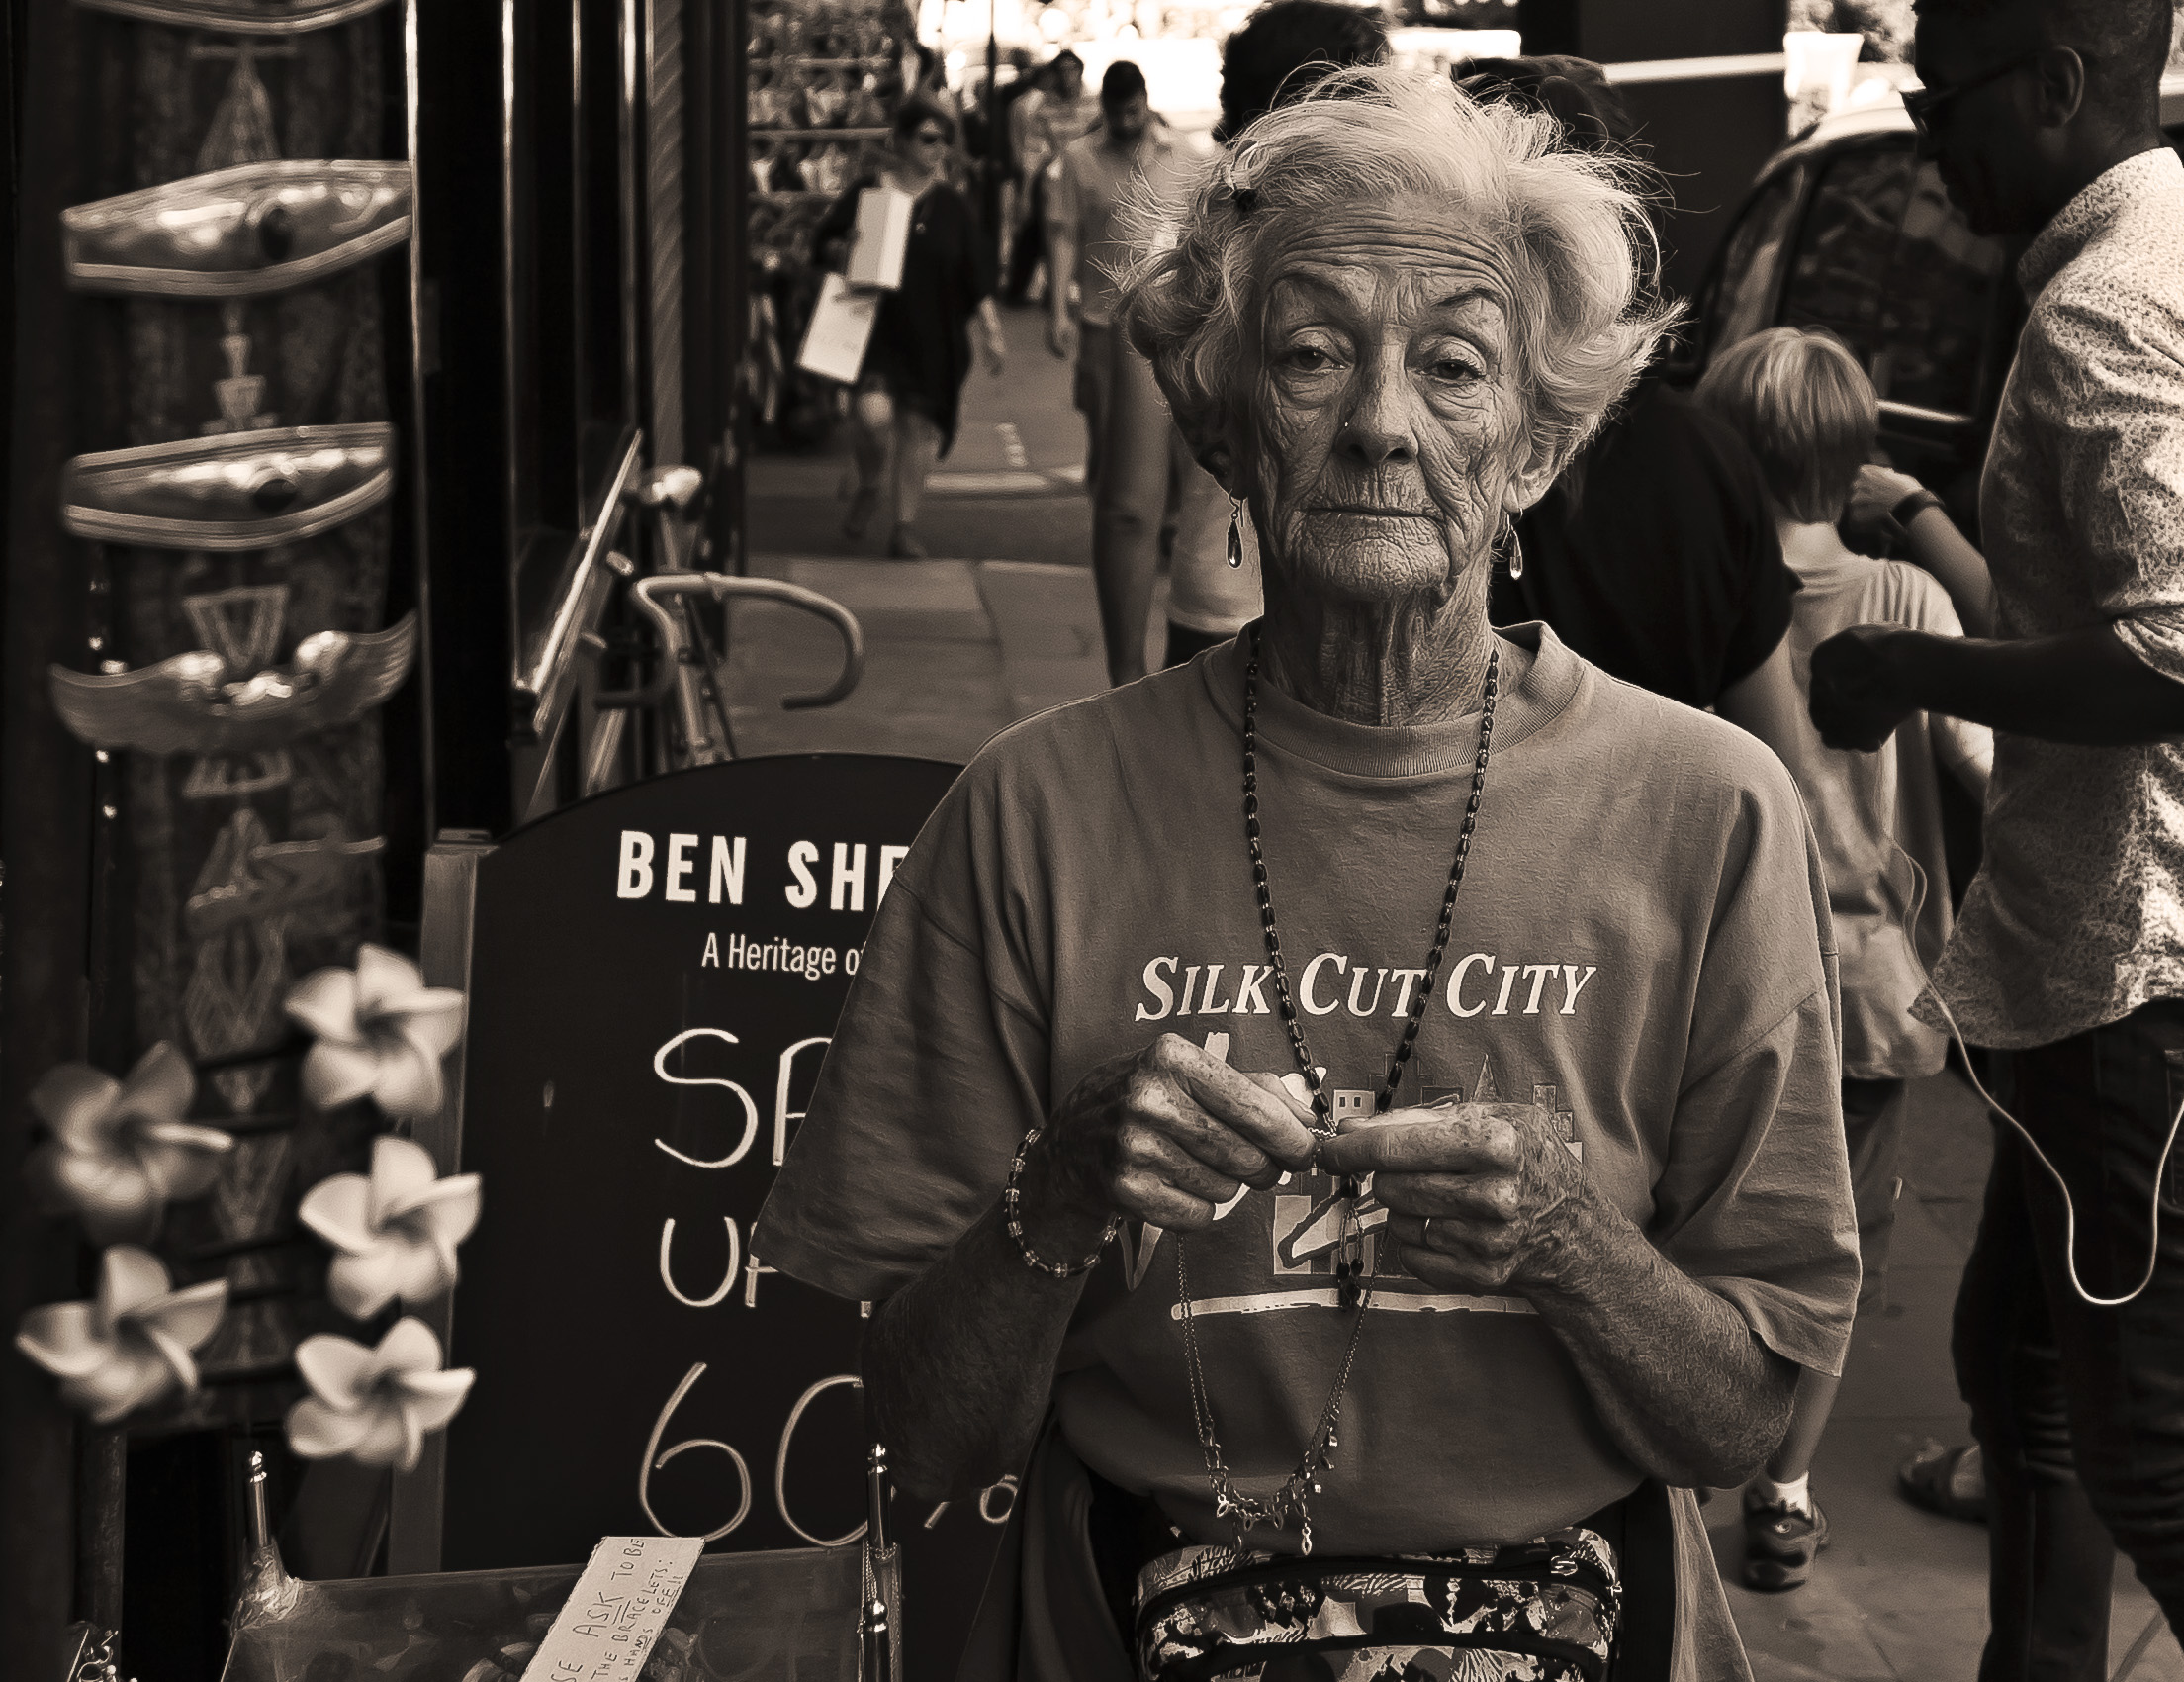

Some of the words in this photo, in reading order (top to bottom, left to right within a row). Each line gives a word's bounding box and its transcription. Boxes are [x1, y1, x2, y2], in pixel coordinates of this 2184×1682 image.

[616, 829, 747, 905] BEN
[701, 932, 720, 968] A
[728, 932, 837, 981] Heritage
[845, 941, 867, 976] o
[1134, 956, 1274, 1022] SILK
[1299, 952, 1428, 1018] CUT
[1446, 952, 1597, 1018] CITY
[572, 1591, 625, 1638] ASK
[591, 1651, 618, 1680] THE
[623, 1628, 654, 1666] HANDS
